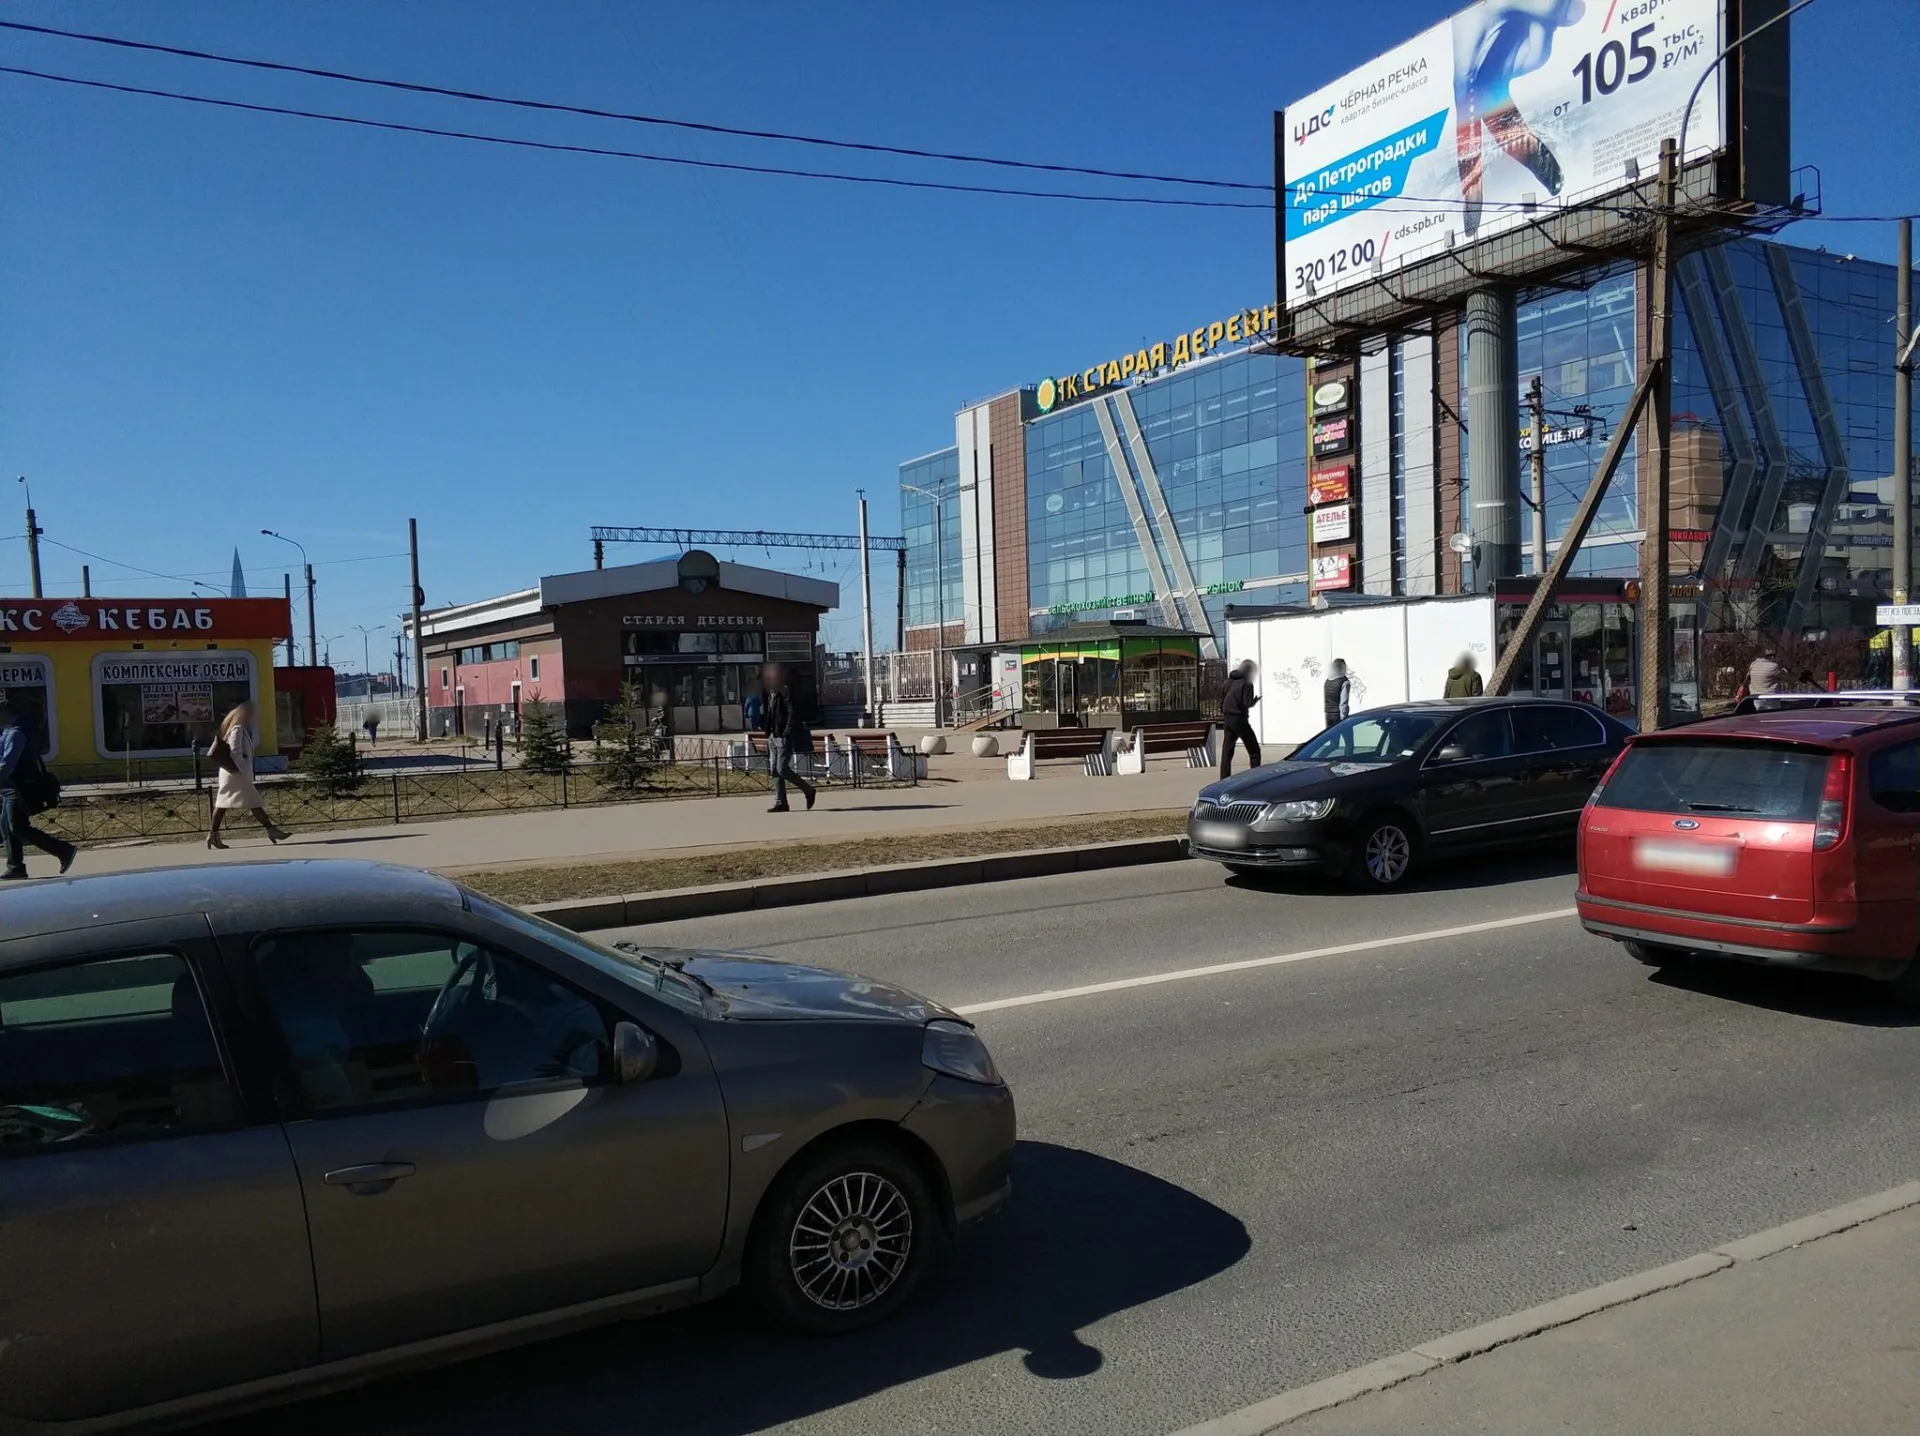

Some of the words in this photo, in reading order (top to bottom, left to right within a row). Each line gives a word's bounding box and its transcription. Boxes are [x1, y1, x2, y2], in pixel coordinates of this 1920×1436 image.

[1621, 0, 1672, 24] квар
[1662, 24, 1700, 48] тыс.
[1340, 78, 1385, 110] ЧЁРНАЯ
[1388, 57, 1428, 88] РЕЧКА
[1553, 101, 1571, 117] от
[1571, 22, 1657, 105] 105
[1340, 105, 1371, 126] квартал
[1372, 75, 1429, 110] бизнес-класса
[1294, 104, 1336, 146] ЦДС
[1294, 180, 1316, 207] До
[1319, 129, 1427, 191] Петроградки
[1303, 199, 1338, 226] пара
[1341, 176, 1392, 209] шагов
[1394, 213, 1445, 240] cds.spb.ru
[1295, 258, 1325, 290] 320
[1328, 249, 1347, 276] 12
[1352, 238, 1375, 266] 00
[1057, 373, 1079, 401] ТК
[1083, 342, 1167, 392] СТАРАЯ
[1316, 510, 1347, 524] АТЕЛЬЕ
[1207, 580, 1245, 595] РЫНОК
[98, 608, 214, 630] КЕБАБ
[622, 615, 685, 625] СТАРАЯ
[697, 615, 764, 626] ДЕРЕВНЯ
[103, 664, 198, 680] КОМПЛЕКСНЫЕ
[203, 662, 247, 679] ОБЕДЫ
